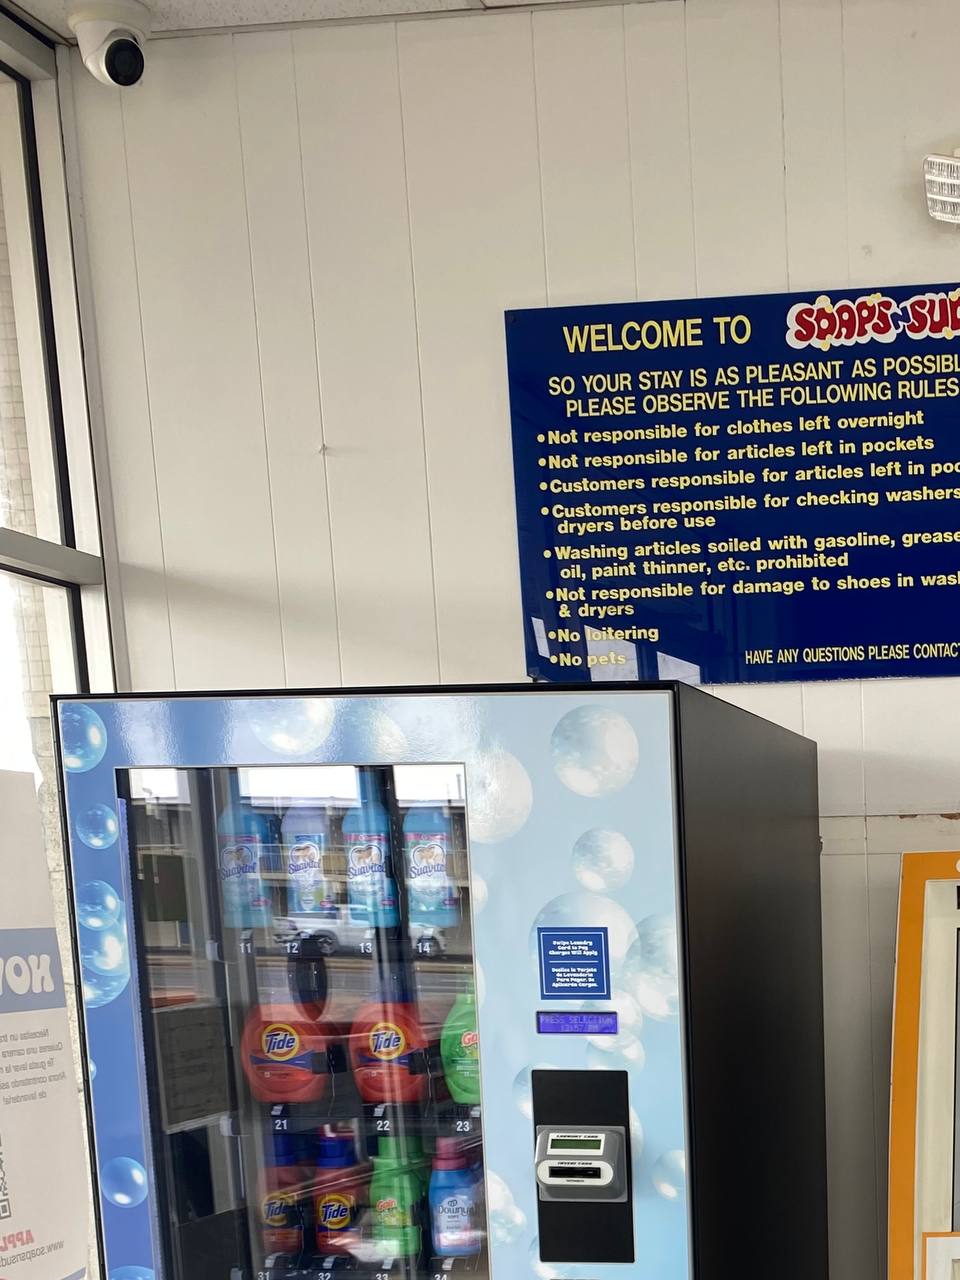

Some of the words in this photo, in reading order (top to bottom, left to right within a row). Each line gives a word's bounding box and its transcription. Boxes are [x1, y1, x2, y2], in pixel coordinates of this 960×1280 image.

[562, 318, 703, 353] WELCOME
[713, 314, 752, 345] TO
[794, 298, 893, 342] SOAPS
[548, 376, 575, 396] SO
[582, 373, 632, 393] YOUR
[638, 370, 683, 390] STAY
[690, 368, 707, 388] IS
[715, 366, 739, 386] AS
[746, 360, 843, 384] PLEASANT
[852, 357, 877, 378] AS
[566, 396, 636, 418] PLEASE
[642, 391, 730, 414] OBSERVE
[737, 388, 774, 408] THE
[780, 381, 892, 407] FOLLOWING
[897, 377, 960, 399] RULES
[548, 429, 578, 445] Not
[584, 424, 688, 444] responsible
[694, 422, 721, 438] for
[727, 418, 793, 436] clothes
[799, 415, 831, 431] left
[837, 410, 924, 430] overnight
[548, 454, 579, 470] Not
[584, 449, 688, 469] responsible
[694, 447, 721, 462] for
[727, 443, 795, 461] articles
[801, 440, 833, 456] left
[839, 440, 856, 454] in
[862, 435, 935, 455] pockets
[554, 544, 628, 561] Washing
[634, 540, 701, 557] articles
[707, 537, 762, 554] soiled
[768, 535, 808, 550] with
[814, 531, 896, 551] gasoline,
[560, 564, 586, 580] oil,
[592, 561, 636, 580] paint
[643, 560, 712, 575] thinner,
[717, 557, 750, 572] etc.
[756, 552, 849, 573] prohibited
[557, 629, 581, 643] No
[586, 626, 659, 642] loitering
[559, 653, 582, 667] No
[587, 652, 627, 667] pets
[745, 650, 773, 665] HAVE
[777, 648, 799, 664] ANY
[803, 645, 865, 663] QUESTIONS
[868, 644, 910, 660] PLEASE
[239, 942, 252, 953] 11
[286, 942, 299, 953] 12
[359, 942, 372, 953] 13
[416, 942, 430, 953] 14
[265, 1033, 296, 1053] Tide
[371, 1032, 401, 1053] Tide
[274, 1119, 288, 1130] 21
[376, 1120, 390, 1131] 22
[456, 1121, 470, 1132] 23
[321, 1203, 348, 1222] Tide
